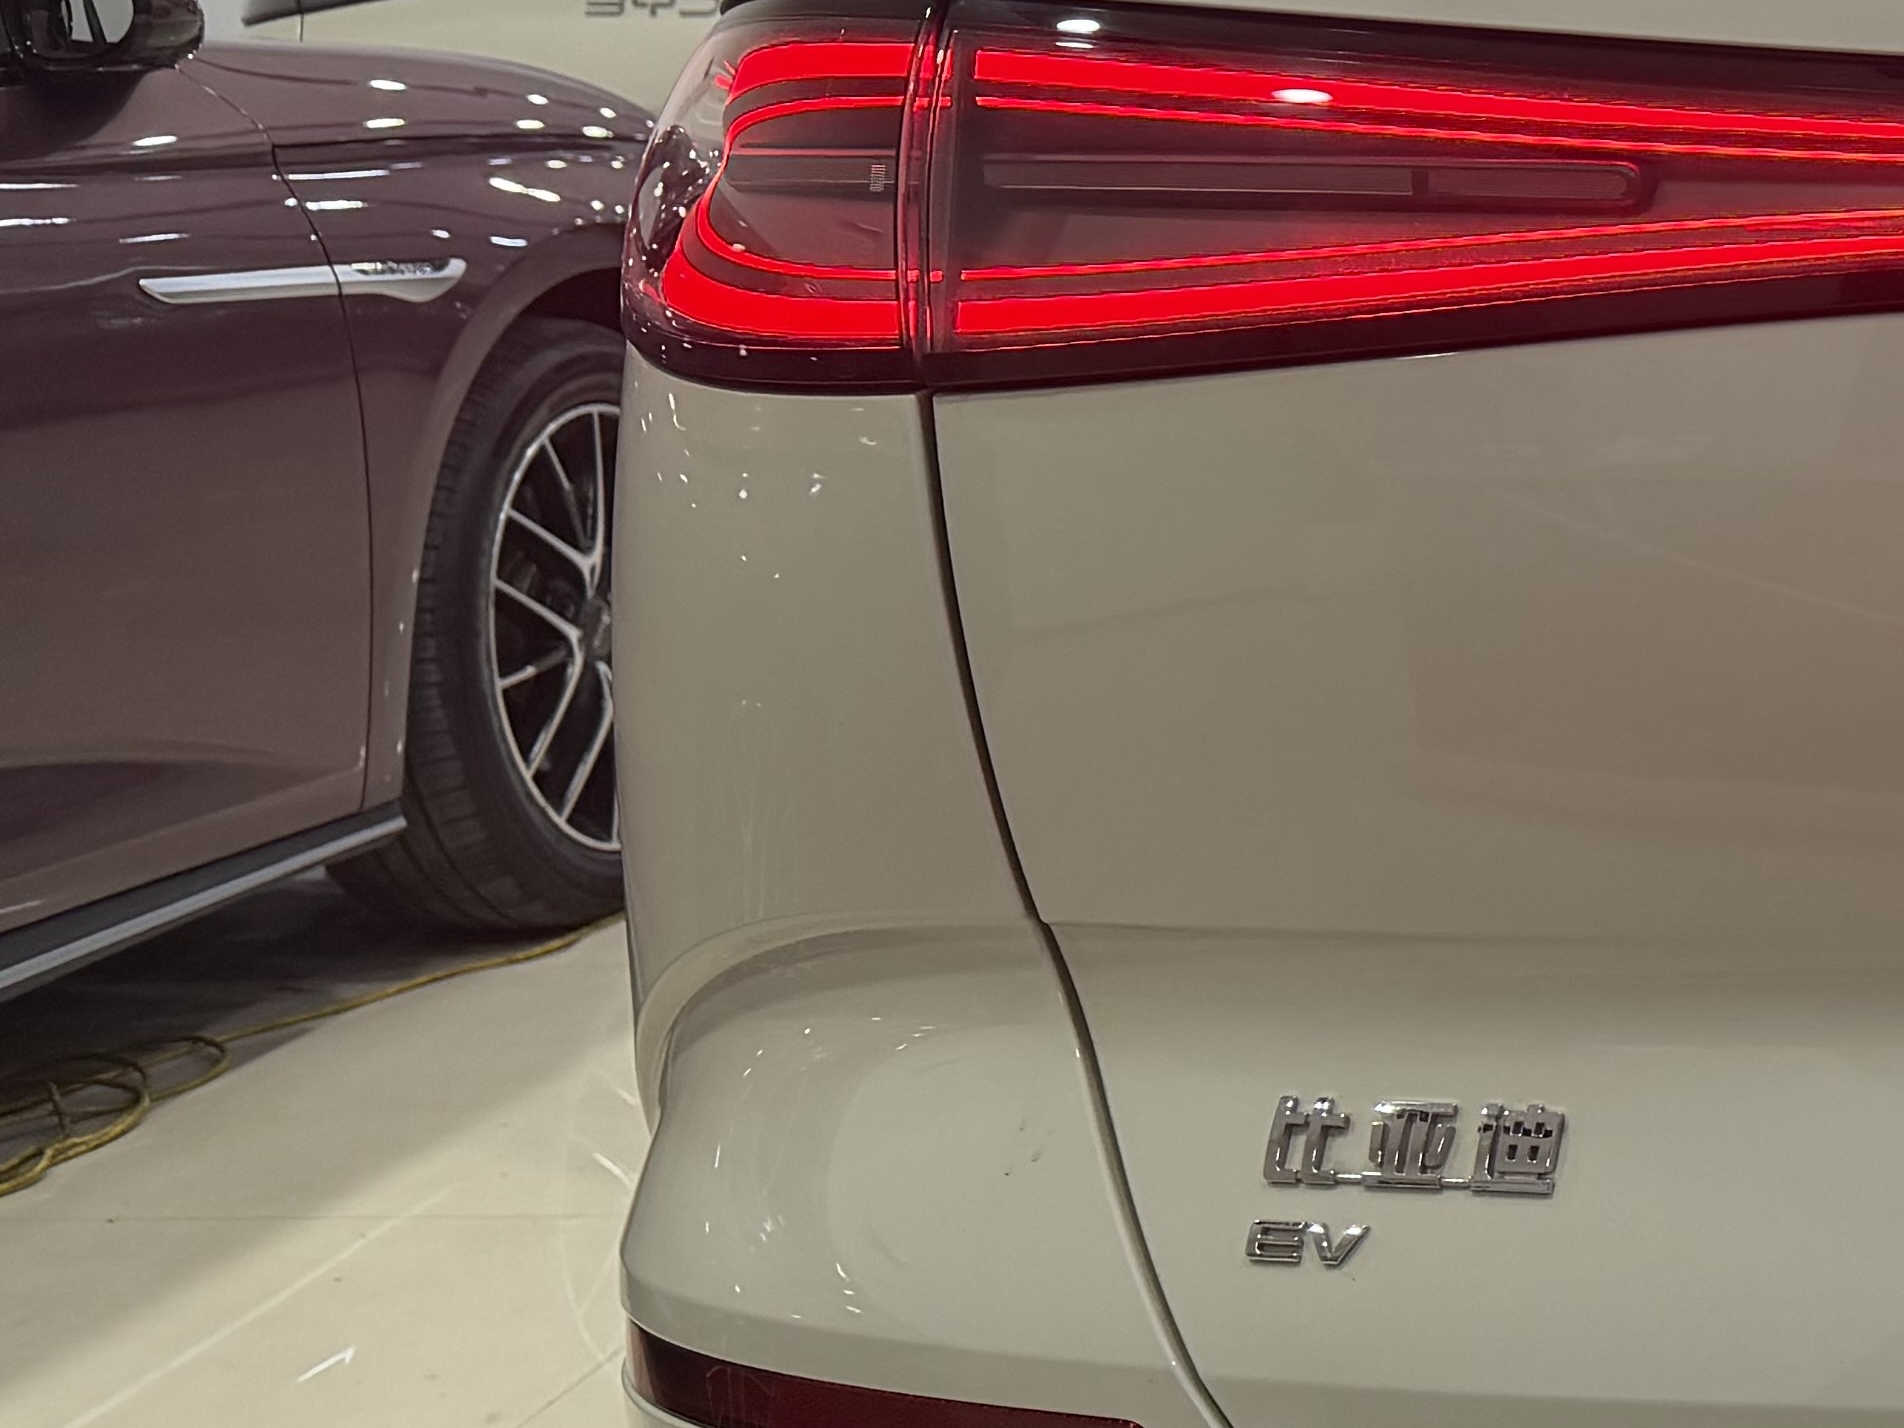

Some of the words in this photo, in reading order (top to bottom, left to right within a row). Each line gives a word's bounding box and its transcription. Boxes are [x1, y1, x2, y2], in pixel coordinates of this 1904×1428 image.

[1263, 1095, 1566, 1197] 比亚迪
[1246, 1218, 1370, 1266] EV
